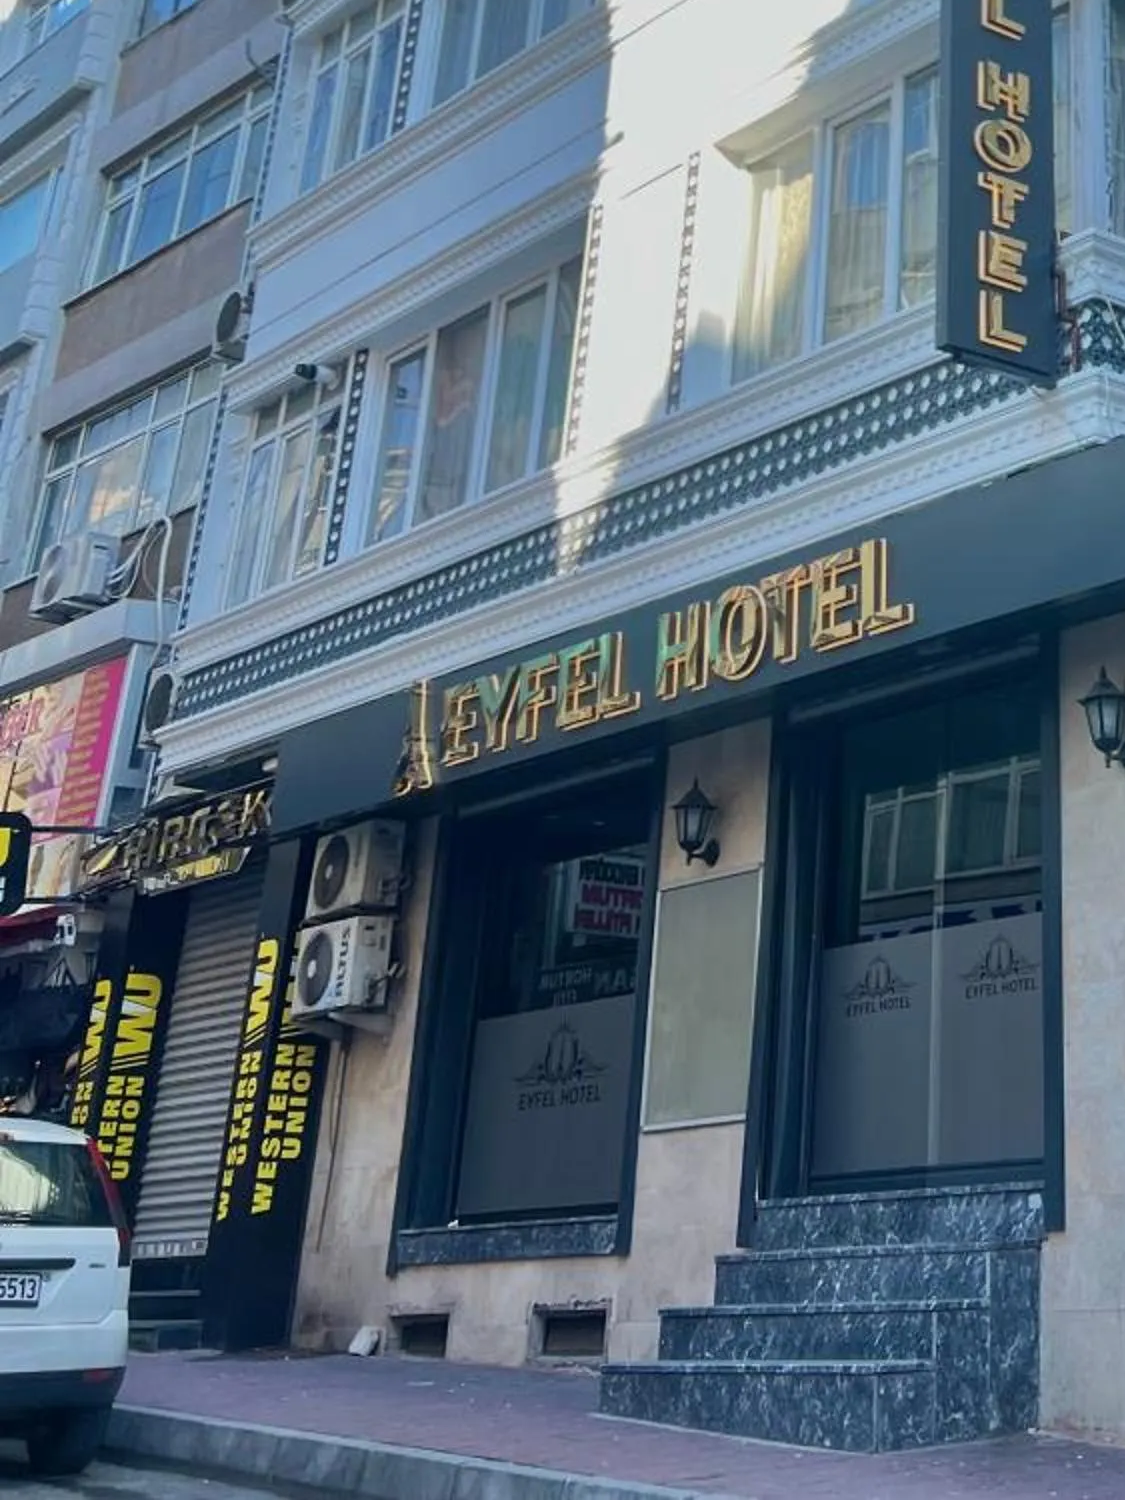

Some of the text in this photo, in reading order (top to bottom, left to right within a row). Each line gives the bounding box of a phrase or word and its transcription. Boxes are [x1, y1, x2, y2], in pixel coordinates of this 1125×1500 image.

[974, 60, 1032, 352] HOTEL
[440, 537, 915, 767] EYFEL HOTEL
[113, 973, 162, 1058] WU
[247, 938, 279, 1036] WU
[1001, 977, 1039, 995] HOTEL
[97, 1076, 126, 1156] TERN
[112, 1076, 145, 1181] UNION
[235, 1051, 263, 1167] UNION
[252, 1044, 295, 1215] WESTERN
[281, 1045, 316, 1160] UNION
[560, 1083, 600, 1107] HOTEL
